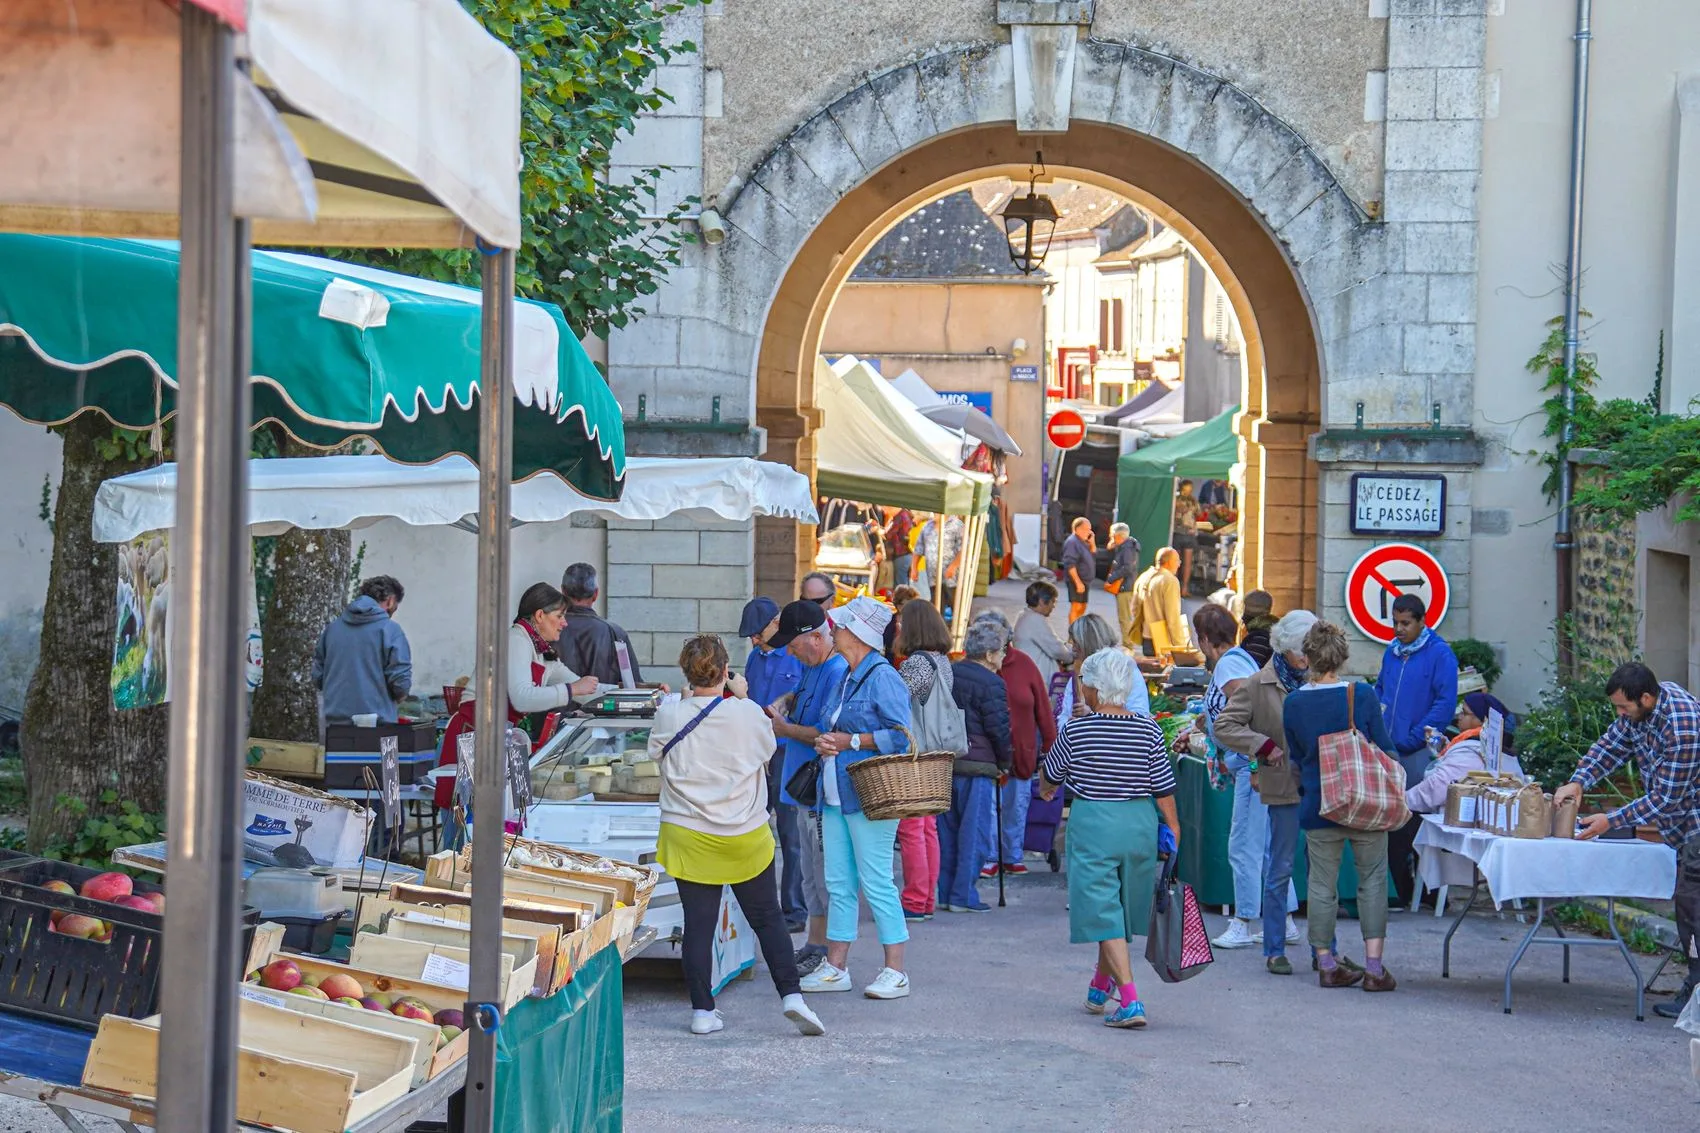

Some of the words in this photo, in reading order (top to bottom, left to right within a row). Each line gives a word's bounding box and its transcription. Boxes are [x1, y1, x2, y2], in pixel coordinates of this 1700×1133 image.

[1377, 484, 1421, 501] CÉDEZ
[1359, 507, 1372, 520] LE
[1380, 508, 1438, 522] PASSAGE
[274, 793, 290, 804] DE
[293, 796, 327, 813] TERRE
